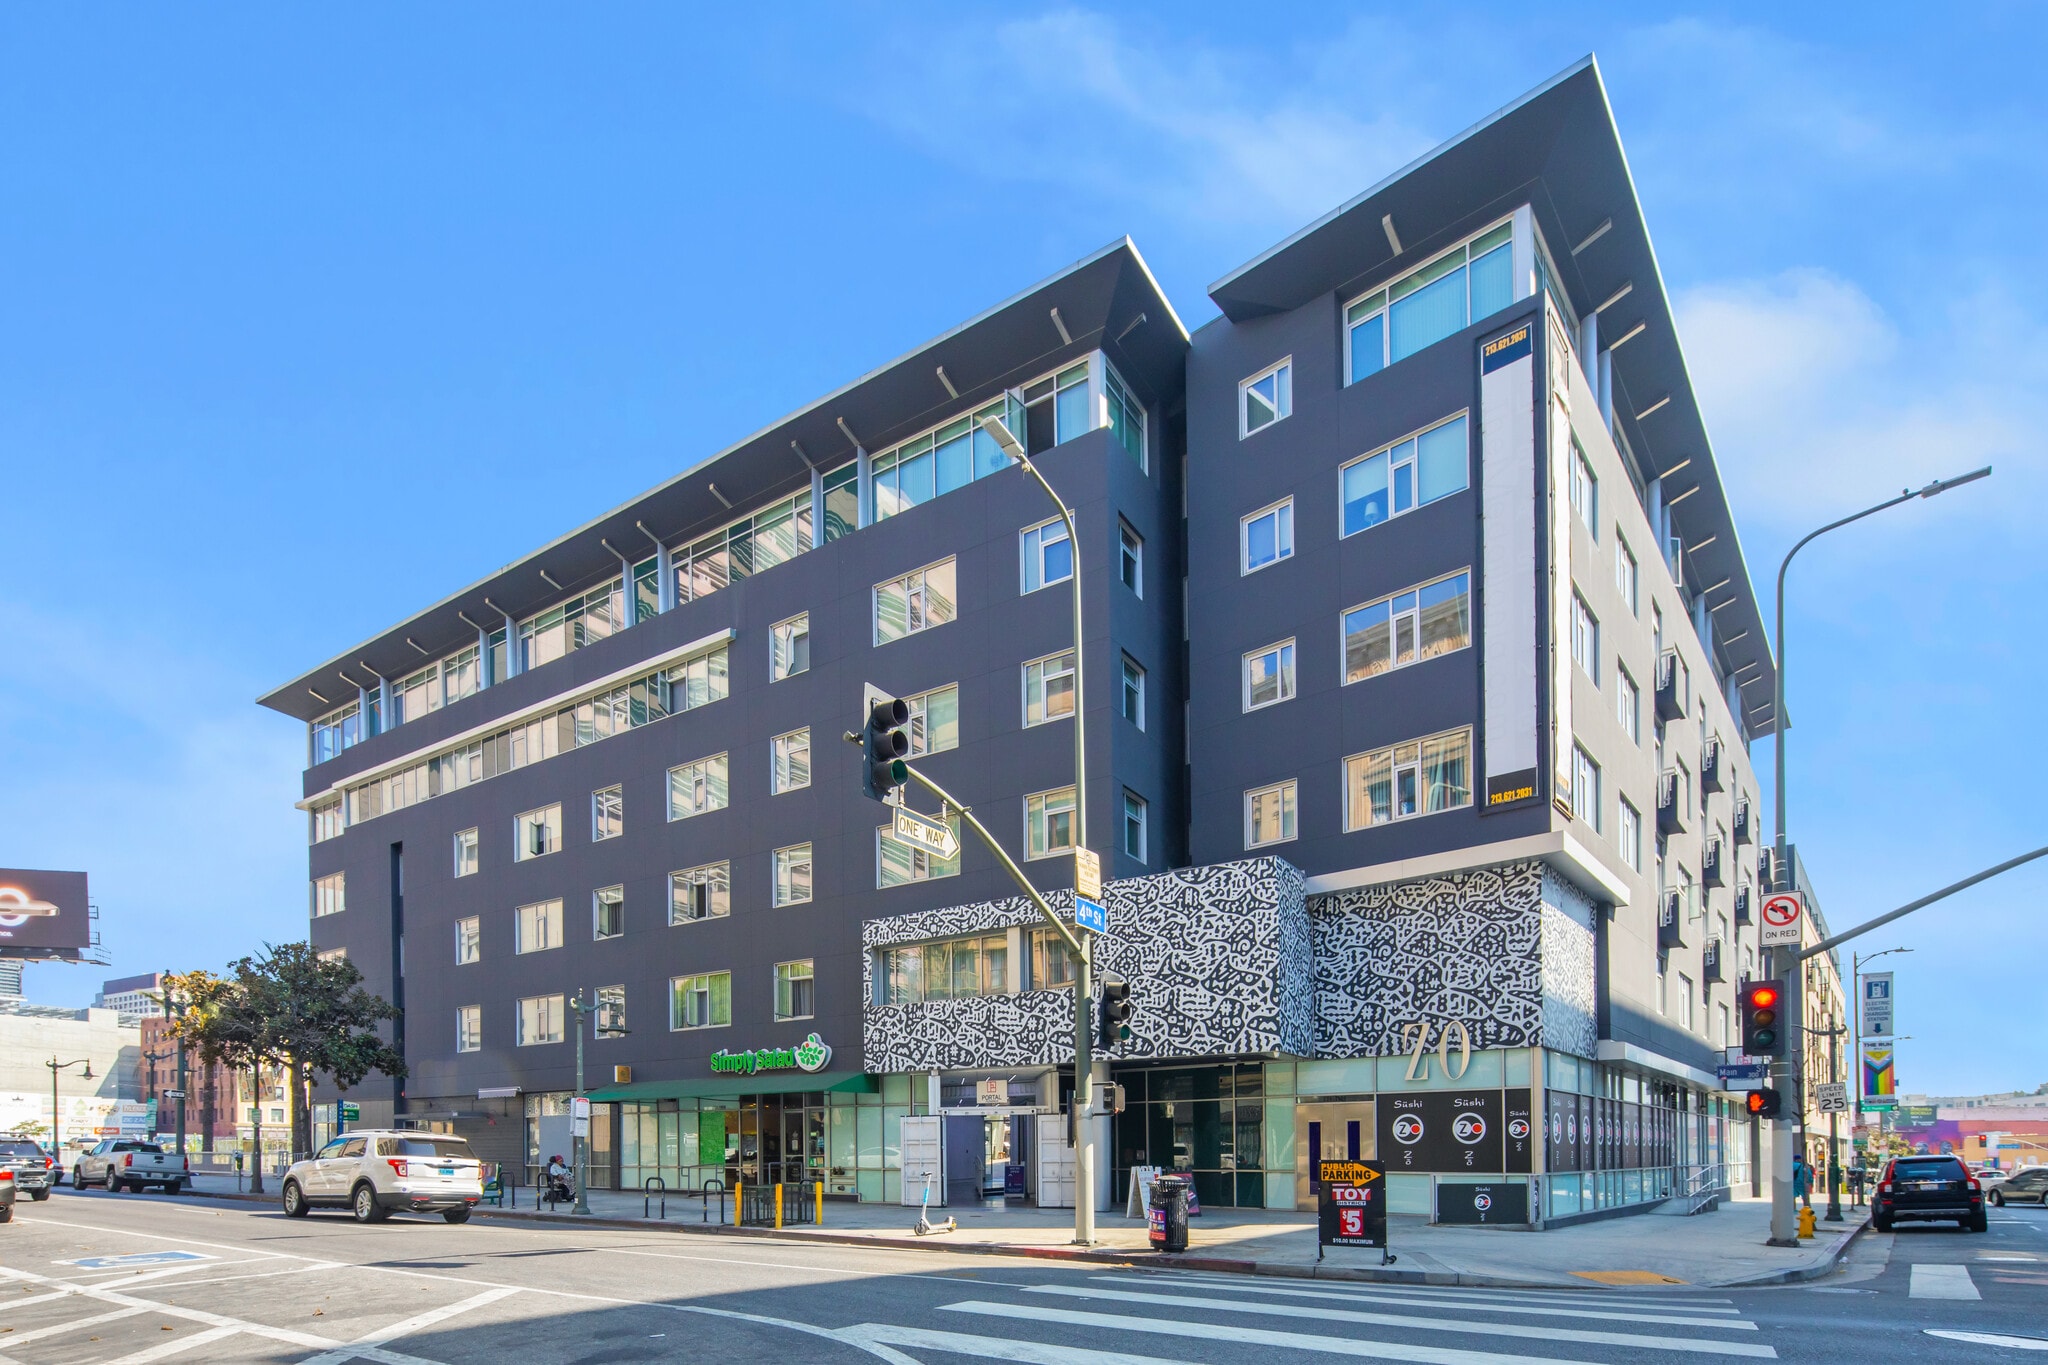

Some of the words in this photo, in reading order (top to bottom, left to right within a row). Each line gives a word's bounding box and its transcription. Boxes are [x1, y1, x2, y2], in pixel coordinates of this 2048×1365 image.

[1485, 328, 1527, 357] 213.621.2031
[1491, 786, 1533, 805] 213.621.2031
[900, 816, 920, 838] ONE
[925, 826, 945, 848] WAY
[1080, 904, 1092, 921] 4th
[1093, 910, 1102, 926] St
[1765, 931, 1777, 939] ON
[1780, 929, 1797, 938] RED
[711, 1050, 755, 1073] Simply
[756, 1047, 794, 1068] Salad
[1403, 1021, 1470, 1080] ZO
[1822, 1098, 1844, 1109] 25
[1321, 1163, 1354, 1171] PUBLIC
[1322, 1170, 1371, 1180] PARKING
[1332, 1188, 1370, 1200] TOY
[1342, 1210, 1361, 1233] $5
